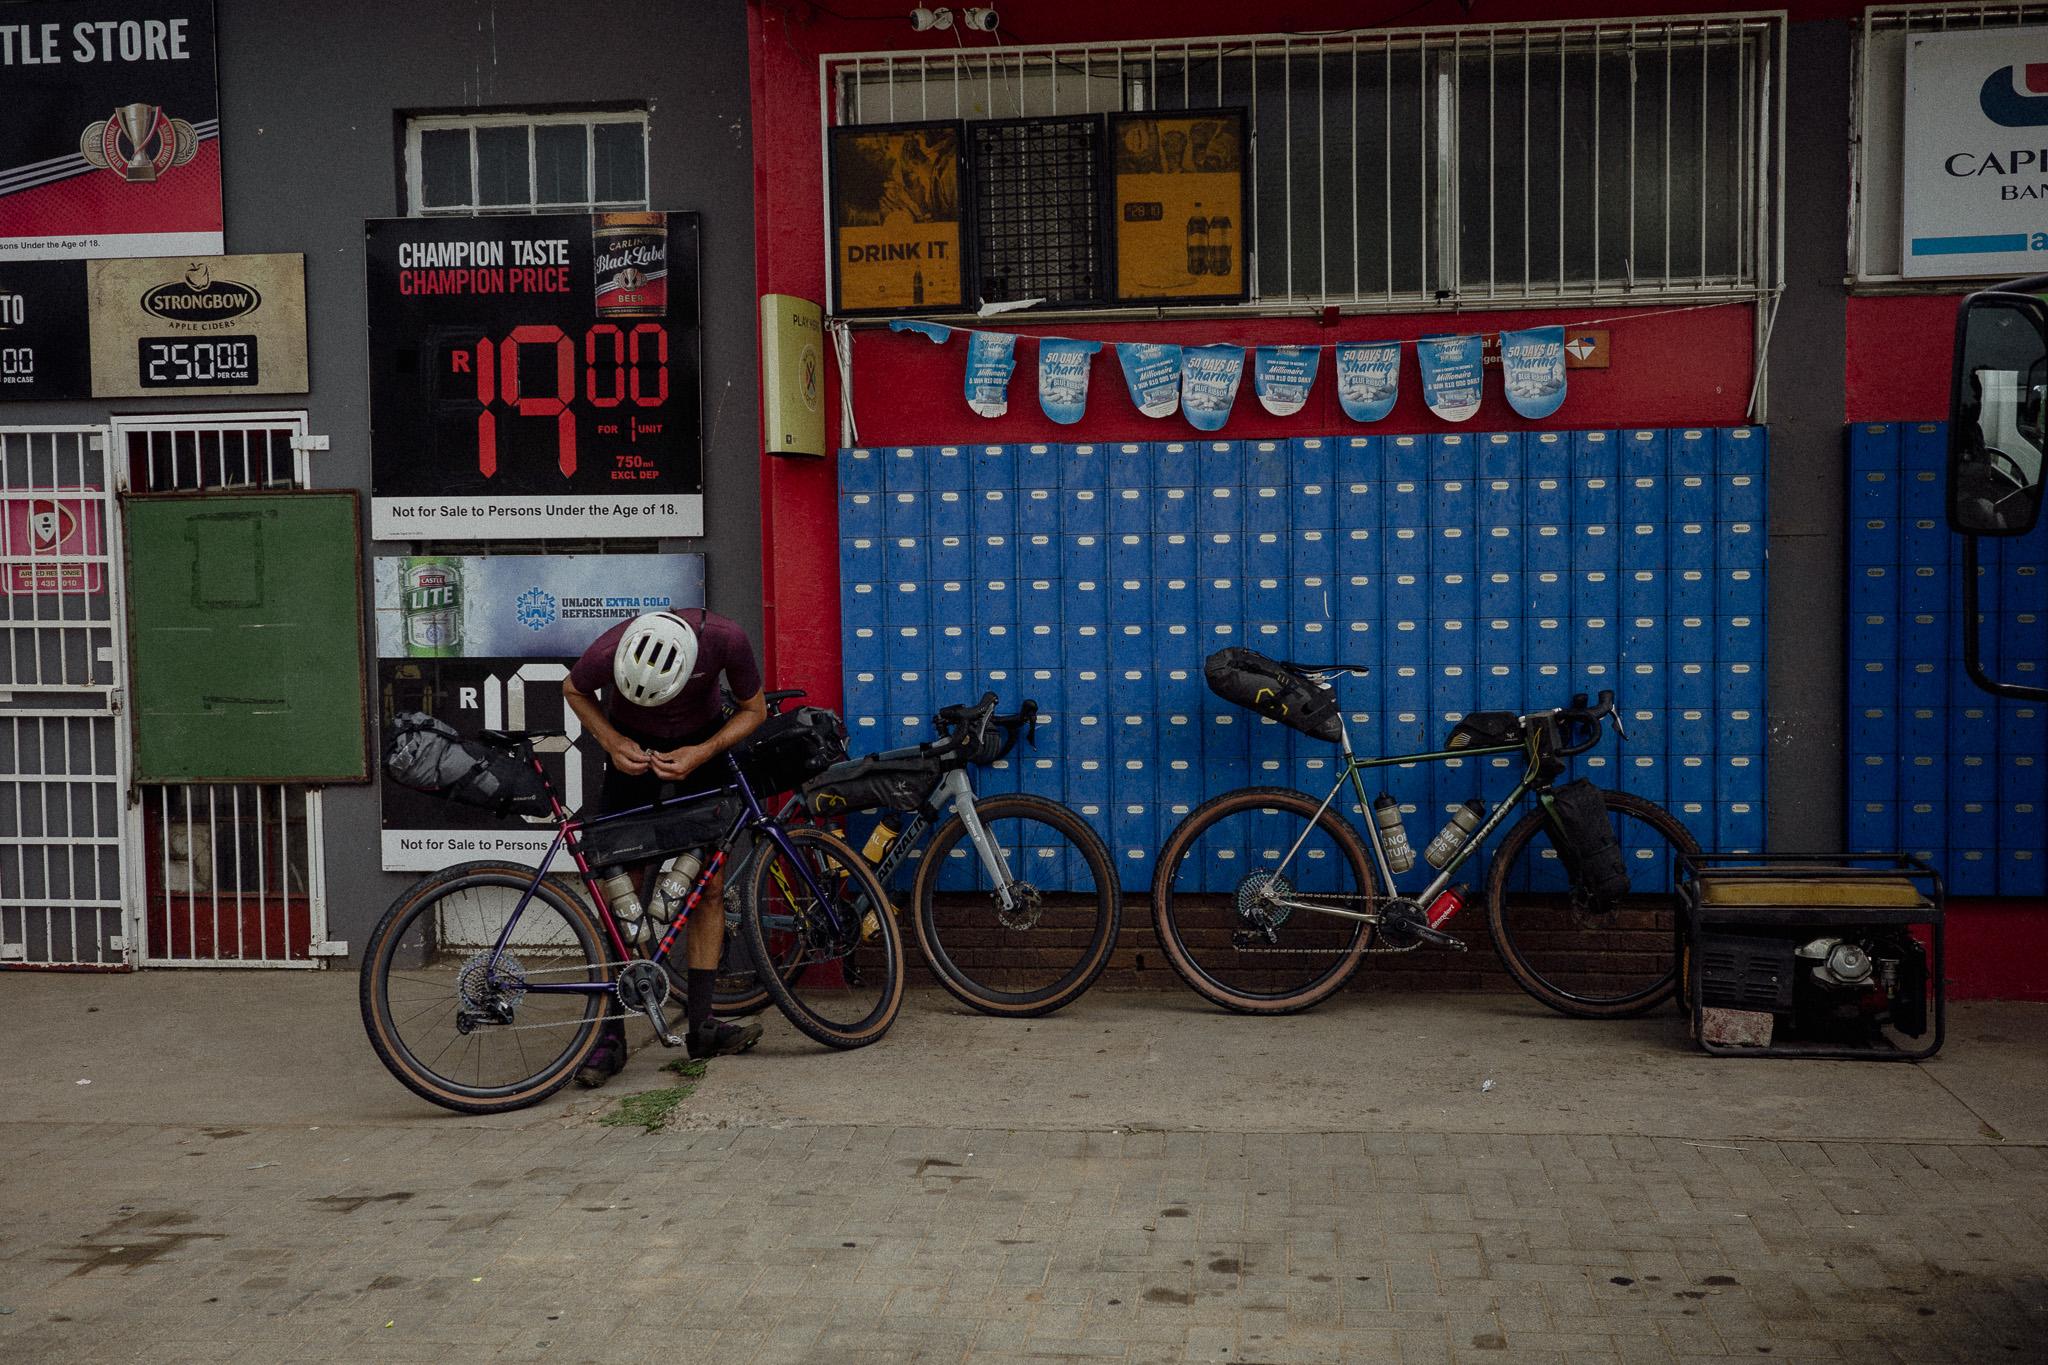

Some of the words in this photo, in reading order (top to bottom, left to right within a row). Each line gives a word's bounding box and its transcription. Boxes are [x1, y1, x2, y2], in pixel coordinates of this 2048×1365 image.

[0, 24, 61, 65] TLE
[73, 19, 190, 63] STORE
[21, 240, 45, 249] Under
[47, 240, 60, 248] the
[61, 240, 77, 250] Age
[79, 240, 88, 248] of
[89, 240, 101, 248] 18.
[399, 240, 504, 268] CHAMPION
[511, 239, 570, 266] TASTE
[846, 241, 921, 264] DRINK
[596, 250, 633, 274] Black
[633, 245, 665, 265] Label
[400, 269, 505, 295] CHAMPION
[509, 267, 571, 293] PRICE
[154, 293, 248, 311] STRONGBOW
[618, 294, 645, 303] BEER
[168, 321, 198, 331] APPLE
[201, 320, 236, 331] CIDERS
[1343, 350, 1356, 360] 50
[1358, 349, 1382, 361] DAYS
[1383, 348, 1396, 361] OF
[1507, 346, 1520, 357] 50
[1521, 345, 1545, 358] DAYS
[1546, 343, 1560, 356] OF
[452, 350, 471, 373] R
[1046, 352, 1059, 363] 50
[1060, 353, 1083, 364] DAYS
[1188, 357, 1202, 368] 50
[1202, 360, 1226, 371] DAYS
[1226, 360, 1240, 372] OF
[1269, 366, 1304, 375] Millionaire
[1343, 359, 1393, 378] Sharing
[1511, 357, 1557, 373] Sharing
[17, 376, 34, 384] CASE
[231, 371, 249, 379] CASE
[1188, 367, 1236, 385] Sharing
[1436, 371, 1472, 382] Millionaire
[1519, 373, 1531, 381] BLUE
[1532, 374, 1551, 382] RIBBON
[1208, 388, 1228, 398] RIBBON
[597, 424, 619, 434] FOR
[637, 424, 663, 434] UNIT
[615, 455, 654, 468] 750ml
[610, 470, 637, 480] EXCL
[639, 470, 660, 479] DEP
[392, 506, 415, 518] Not
[418, 506, 437, 517] for
[440, 505, 468, 518] Sale
[470, 506, 485, 517] to
[488, 505, 542, 517] Persons
[546, 504, 586, 517] Under
[588, 504, 610, 516] the
[612, 504, 638, 518] Age
[642, 504, 657, 515] of
[660, 504, 678, 515] 18.
[46, 569, 80, 577] RESONSE
[411, 586, 454, 609] LITE
[562, 597, 603, 607] UNLOCK
[605, 597, 640, 607] EXTRA
[643, 597, 671, 607] COLD
[561, 609, 640, 619] REFRESHMENT
[459, 687, 478, 709] R
[401, 839, 423, 850] Not
[425, 839, 444, 850] for
[447, 839, 475, 850] Sale
[478, 840, 492, 850] to
[495, 839, 548, 850] Persons
